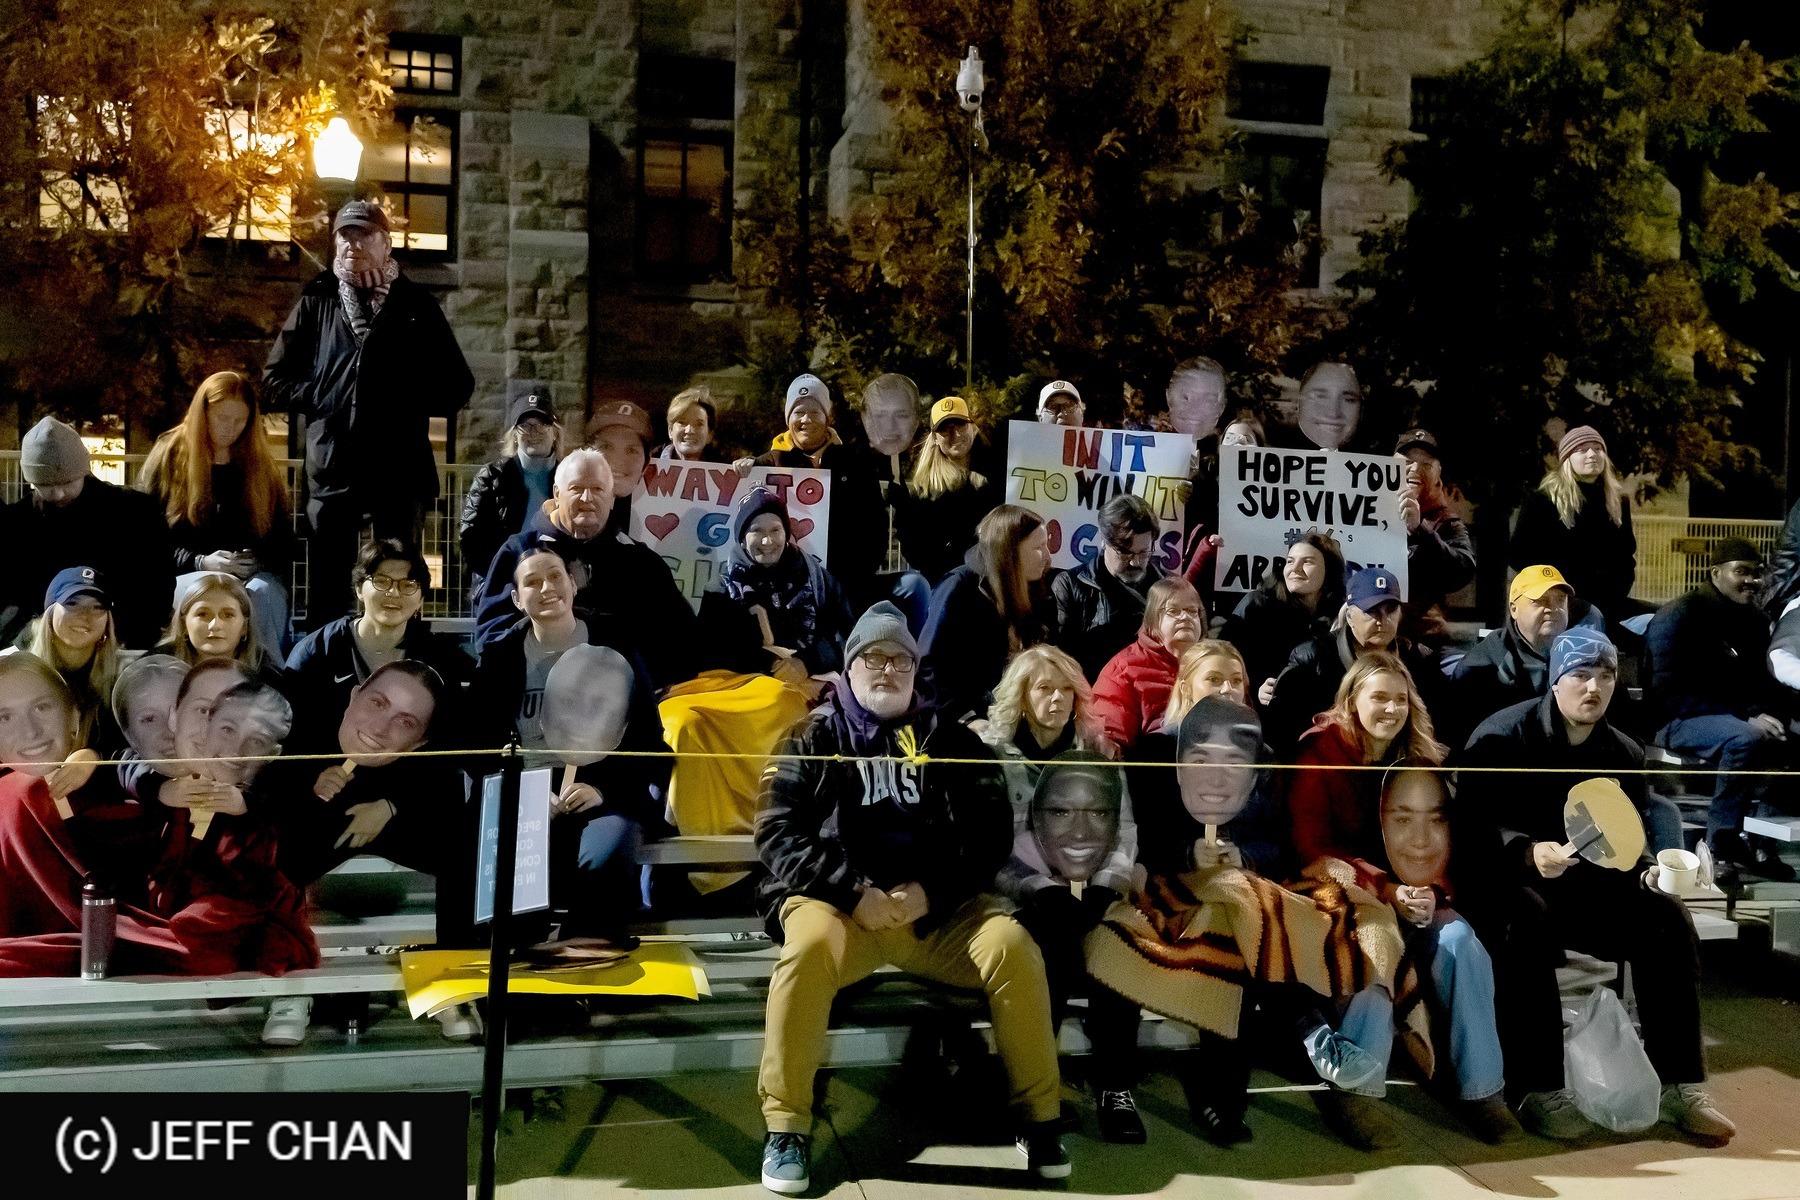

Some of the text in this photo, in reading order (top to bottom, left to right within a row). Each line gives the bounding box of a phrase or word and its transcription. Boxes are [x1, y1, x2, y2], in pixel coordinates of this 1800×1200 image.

[1062, 429, 1156, 472] IN IT
[1237, 450, 1401, 492] HOPE YOU
[643, 463, 824, 507] WAY TO
[1011, 467, 1189, 521] TO WIN IT
[1237, 484, 1388, 532] SURVIVE,
